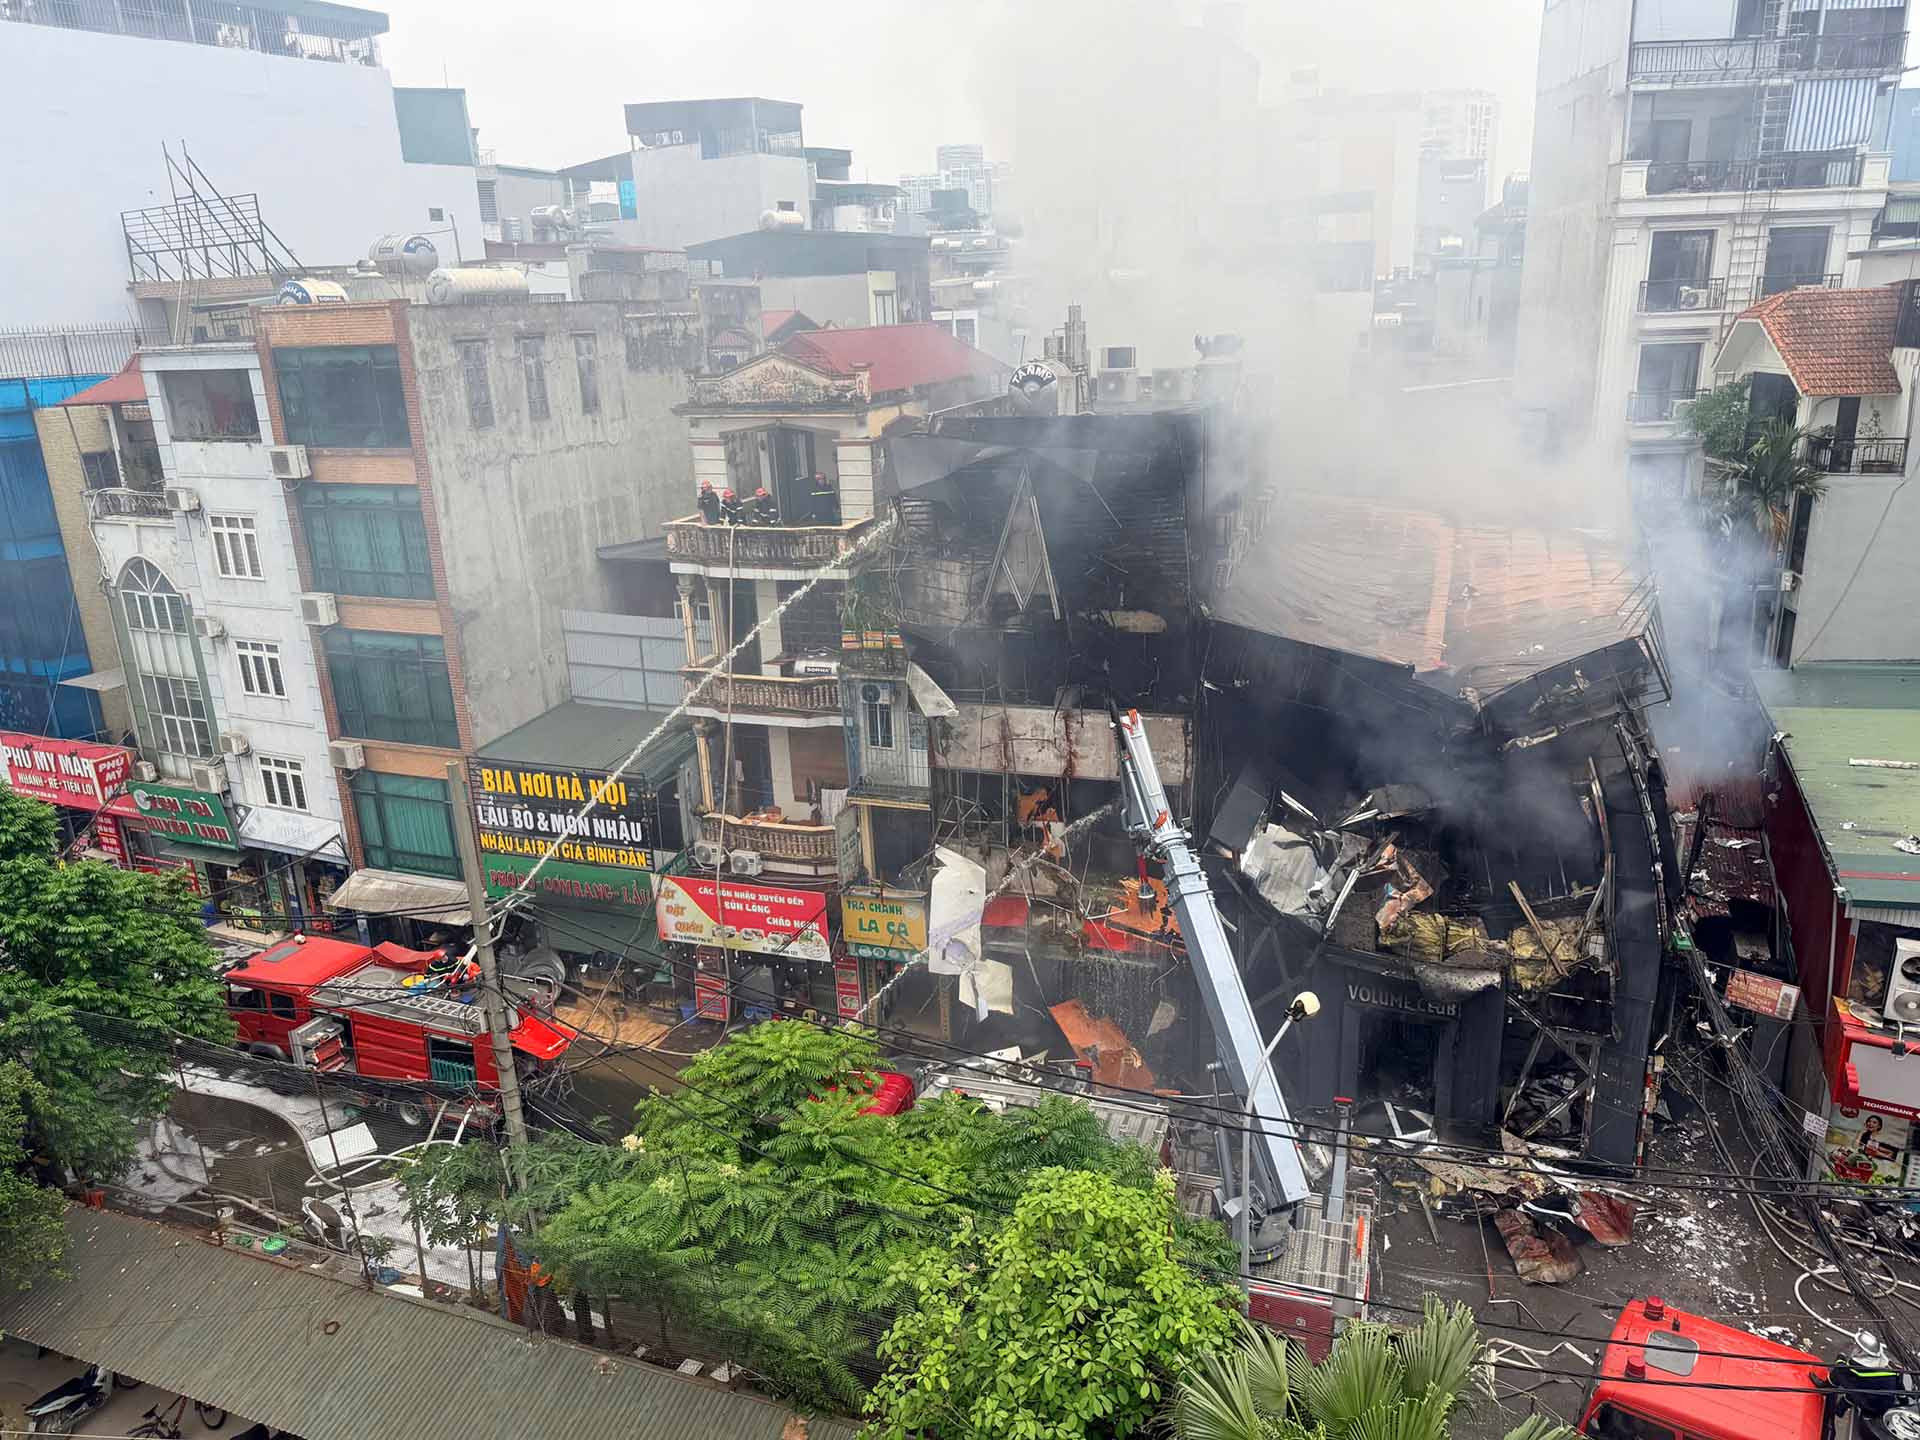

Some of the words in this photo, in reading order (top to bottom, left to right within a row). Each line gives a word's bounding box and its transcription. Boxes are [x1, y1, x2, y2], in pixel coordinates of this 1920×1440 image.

[481, 767, 517, 794] BIA
[519, 771, 554, 799] HƠI
[555, 771, 585, 801] HÀ
[588, 775, 628, 811] NỘI
[476, 794, 509, 827] LẨU
[511, 803, 535, 831] BÒ
[536, 811, 550, 832] &
[592, 814, 643, 845] NHẬU
[480, 831, 513, 854] NHẬU
[515, 836, 537, 855] LAI
[561, 838, 584, 861] GIÁ
[586, 840, 618, 864] BÌNH
[858, 917, 880, 933] LA
[1349, 984, 1412, 1011] VOLUME
[1863, 1101, 1915, 1117] TECHCOMBANK
